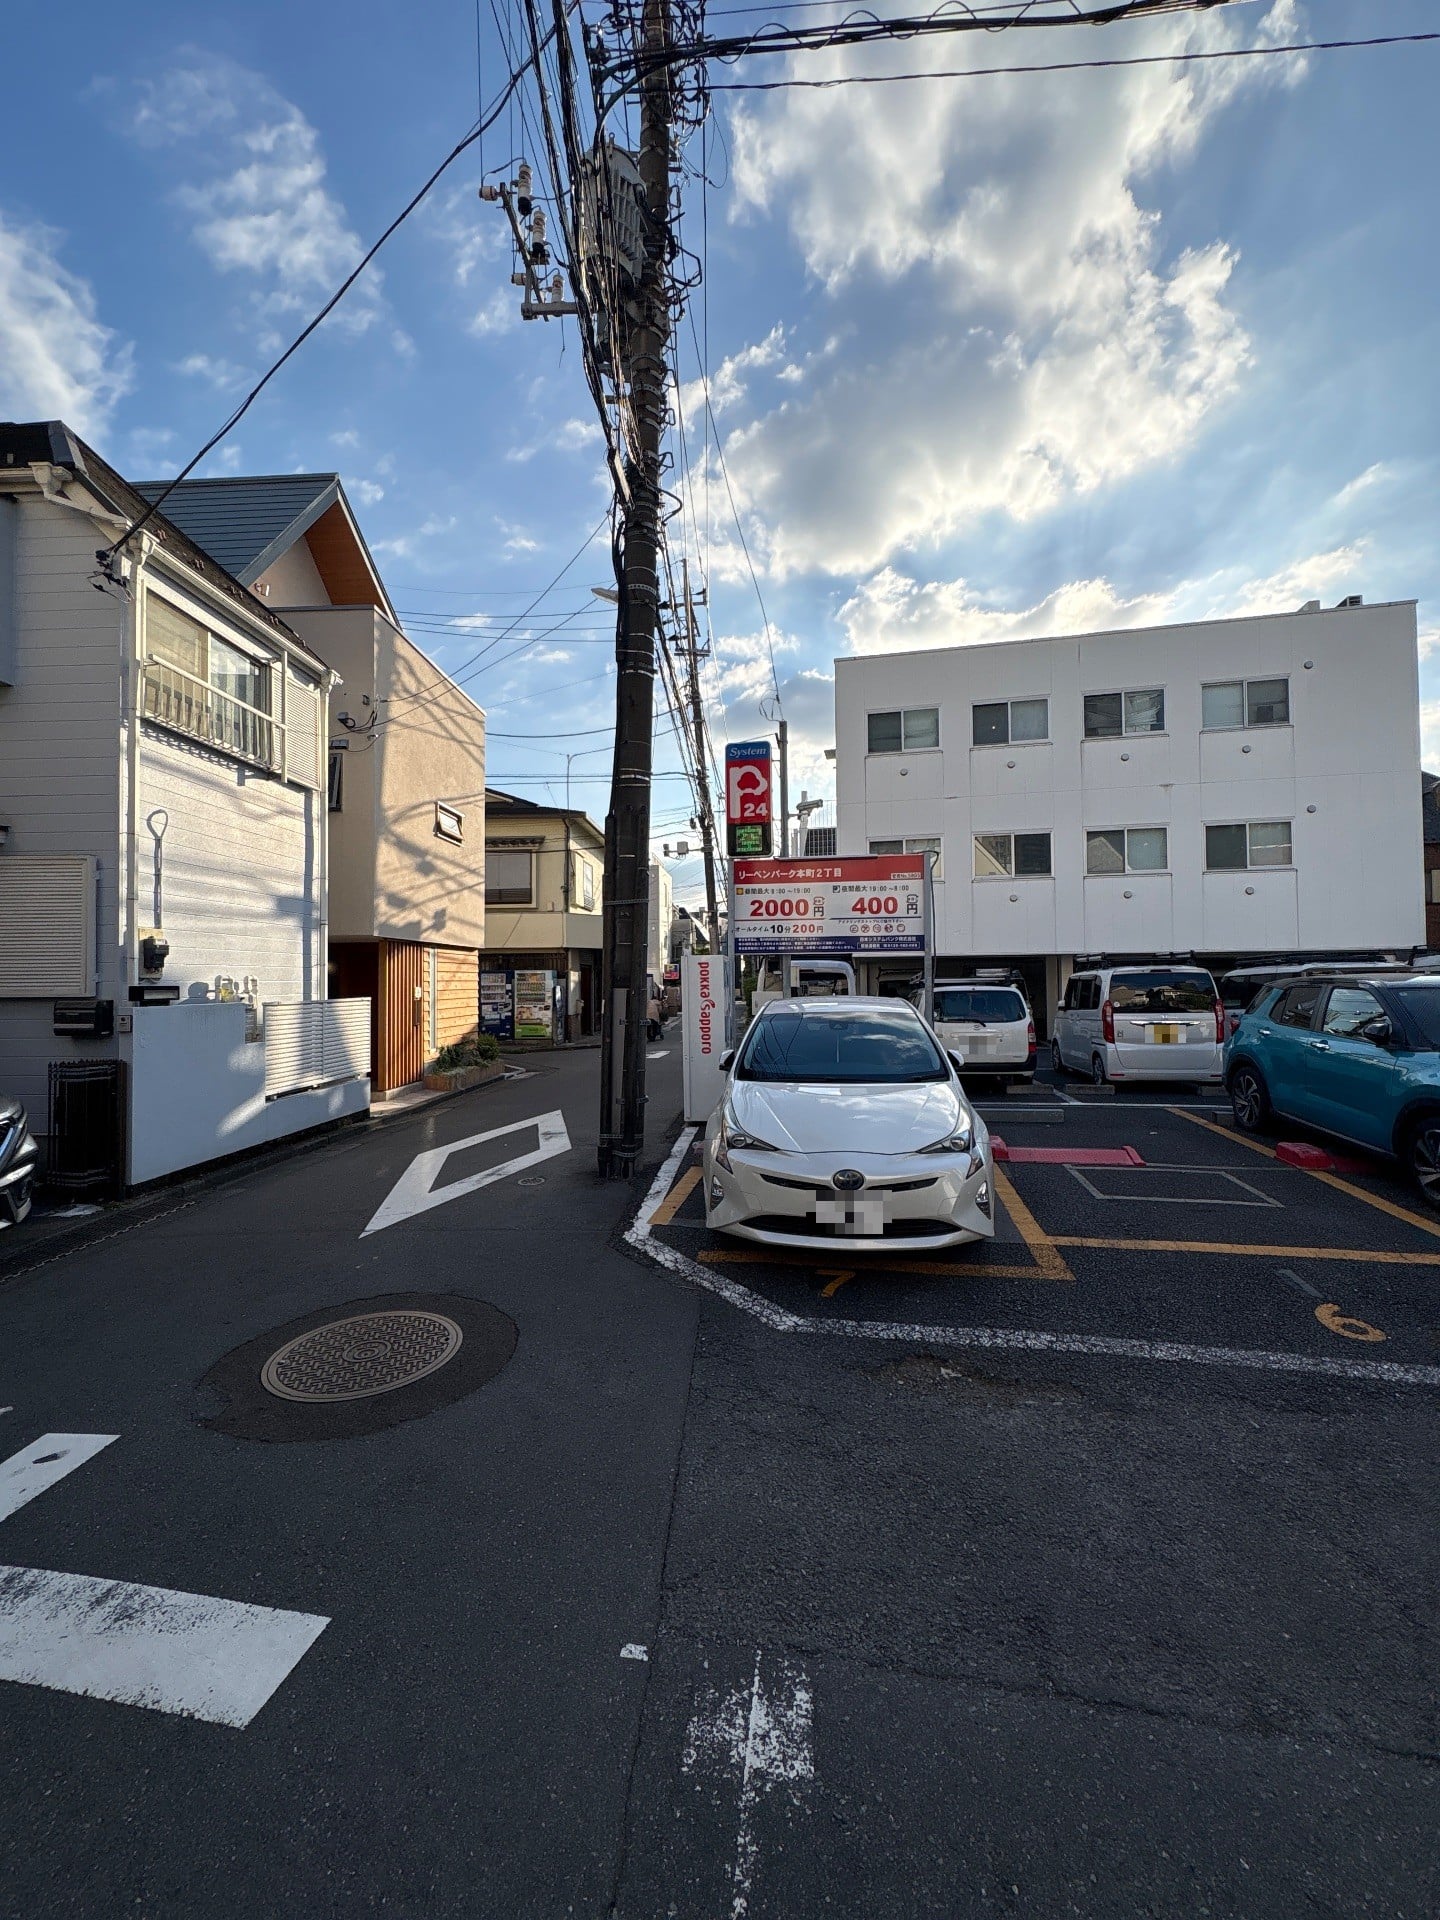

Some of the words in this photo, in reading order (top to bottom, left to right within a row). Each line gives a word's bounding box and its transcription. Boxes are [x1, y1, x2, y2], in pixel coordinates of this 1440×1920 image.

[729, 747, 767, 758] System
[743, 802, 768, 817] 24
[697, 961, 710, 998] pokka
[699, 1003, 712, 1055] sapporo
[1314, 1303, 1387, 1342] 6
